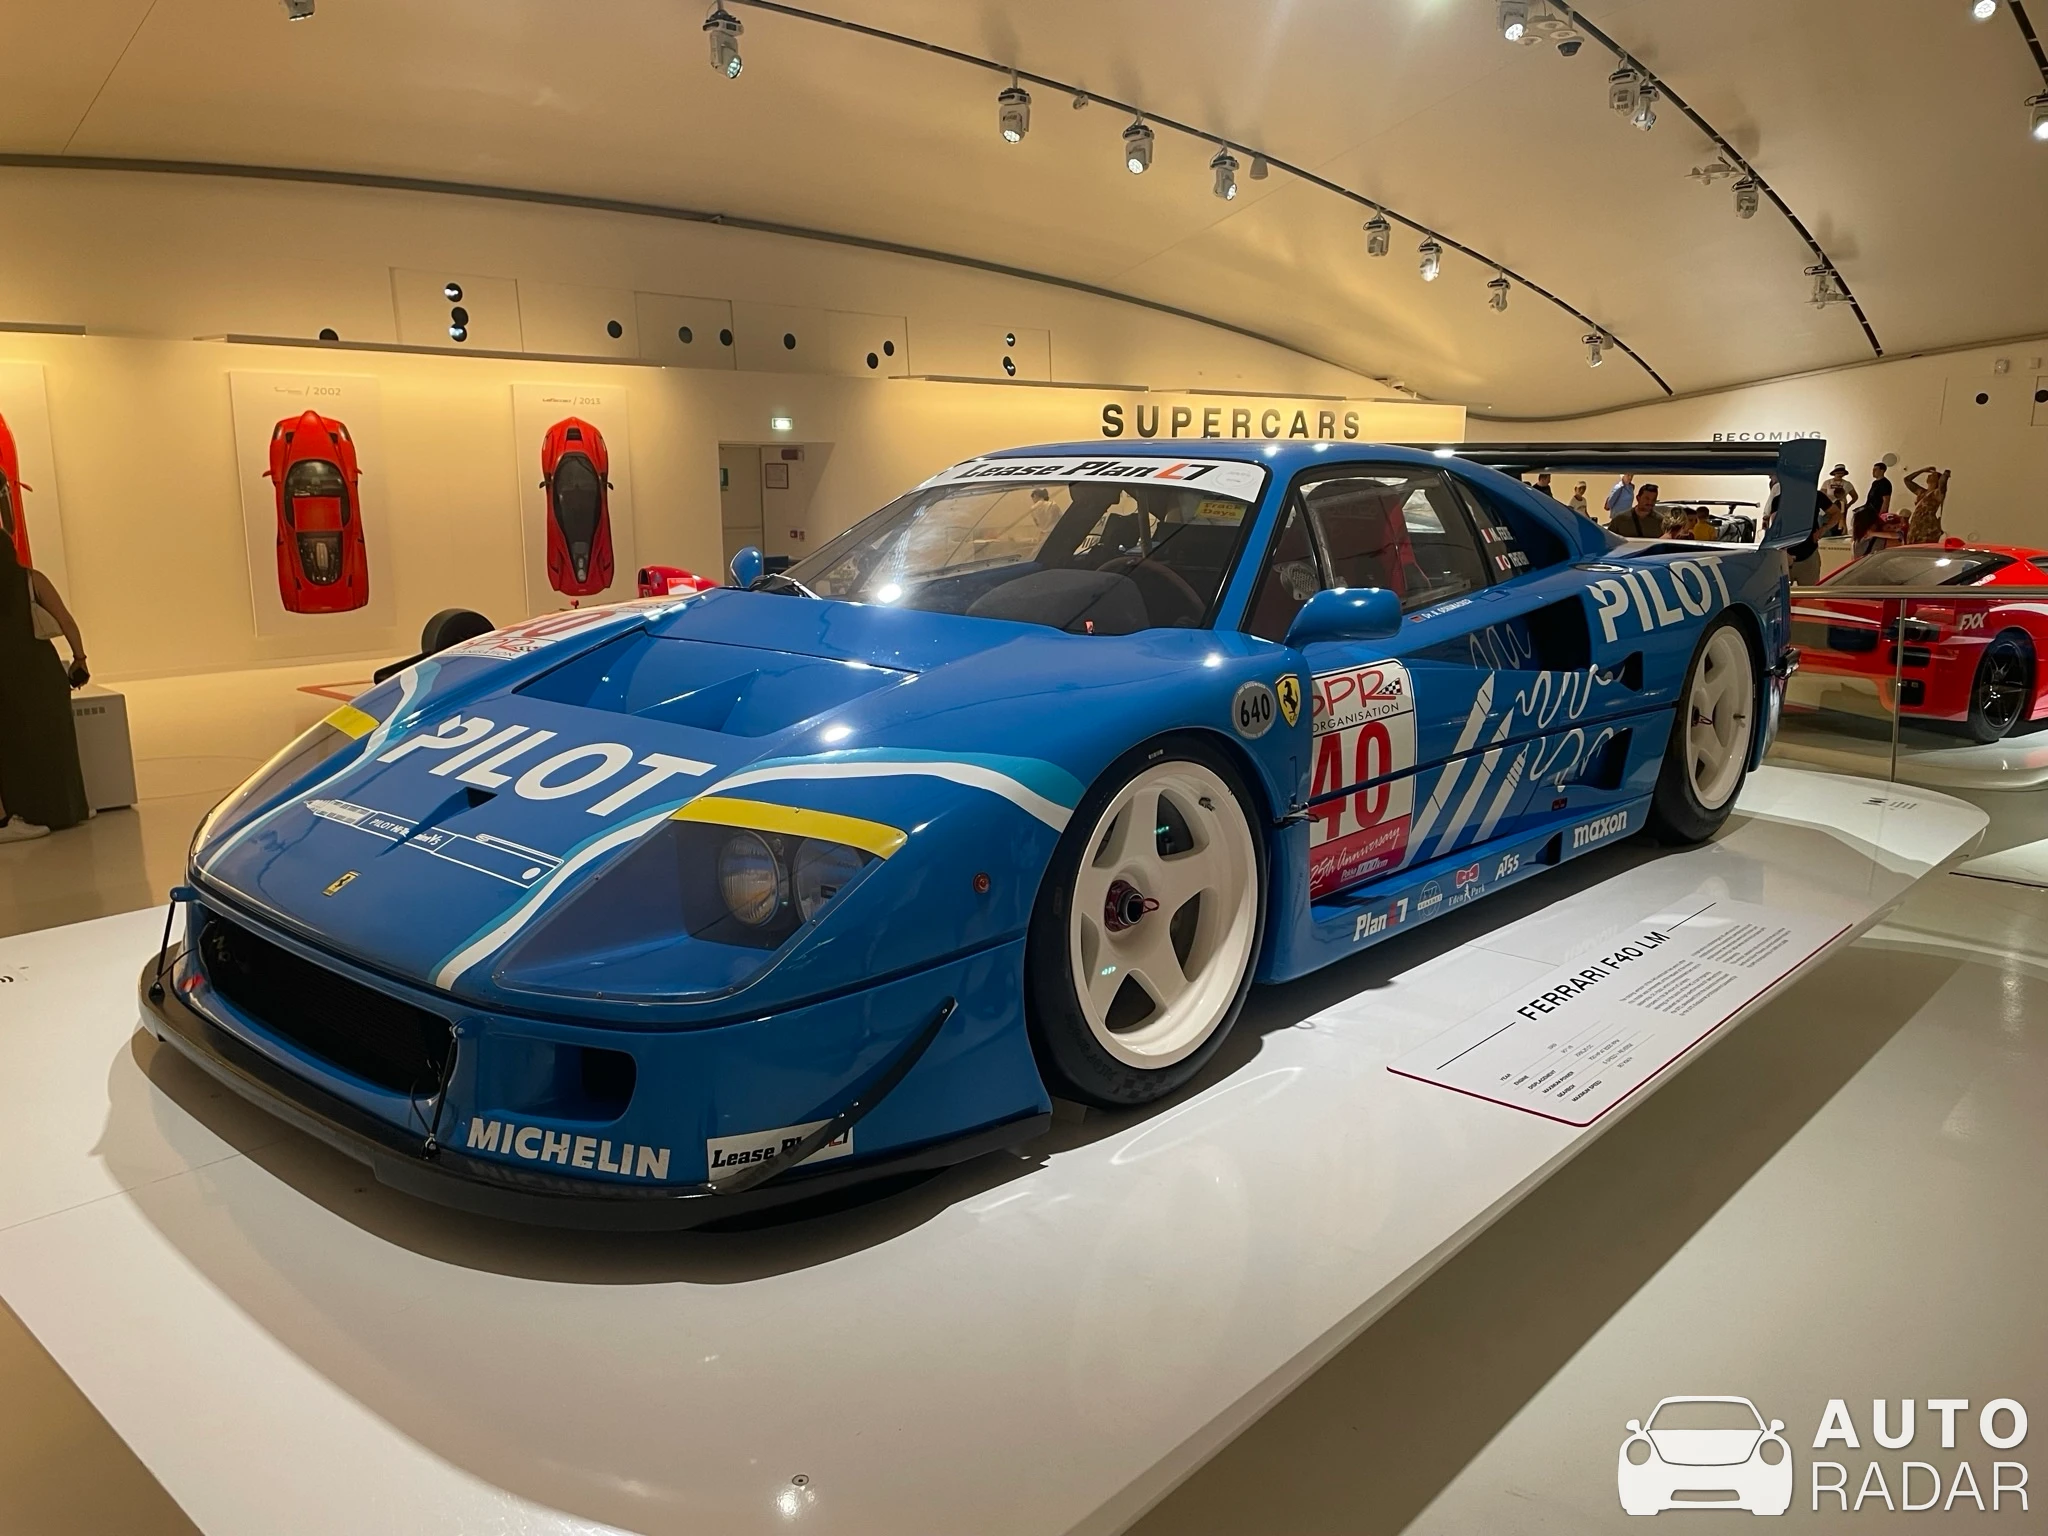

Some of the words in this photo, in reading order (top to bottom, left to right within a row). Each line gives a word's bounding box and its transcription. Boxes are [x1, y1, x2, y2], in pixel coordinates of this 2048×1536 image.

[313, 386, 342, 396] 2002
[579, 397, 601, 405] 2013
[1101, 403, 1360, 439] SUPERCARS
[1712, 431, 1821, 443] BECOMING
[953, 463, 1064, 480] Lease
[1060, 461, 1156, 478] Plan
[1585, 556, 1731, 643] PILOT
[1959, 612, 1989, 631] FXX
[1240, 693, 1271, 727] 640
[1312, 702, 1400, 734] ORGANISATION
[376, 714, 718, 818] PILOT
[1309, 721, 1393, 842] 40
[368, 818, 393, 832] PILOT
[1573, 810, 1627, 849] maxon
[1310, 856, 1337, 886] 25th
[1336, 827, 1401, 871] Anniversary
[1449, 894, 1464, 907] Eden
[1471, 883, 1486, 897] Park
[1353, 913, 1388, 942] Plan
[1516, 965, 1611, 1021] FERRARI
[1600, 946, 1644, 970] F40
[1634, 931, 1671, 950] LM
[465, 1116, 672, 1180] MICHELIN
[711, 1148, 775, 1169] Lease
